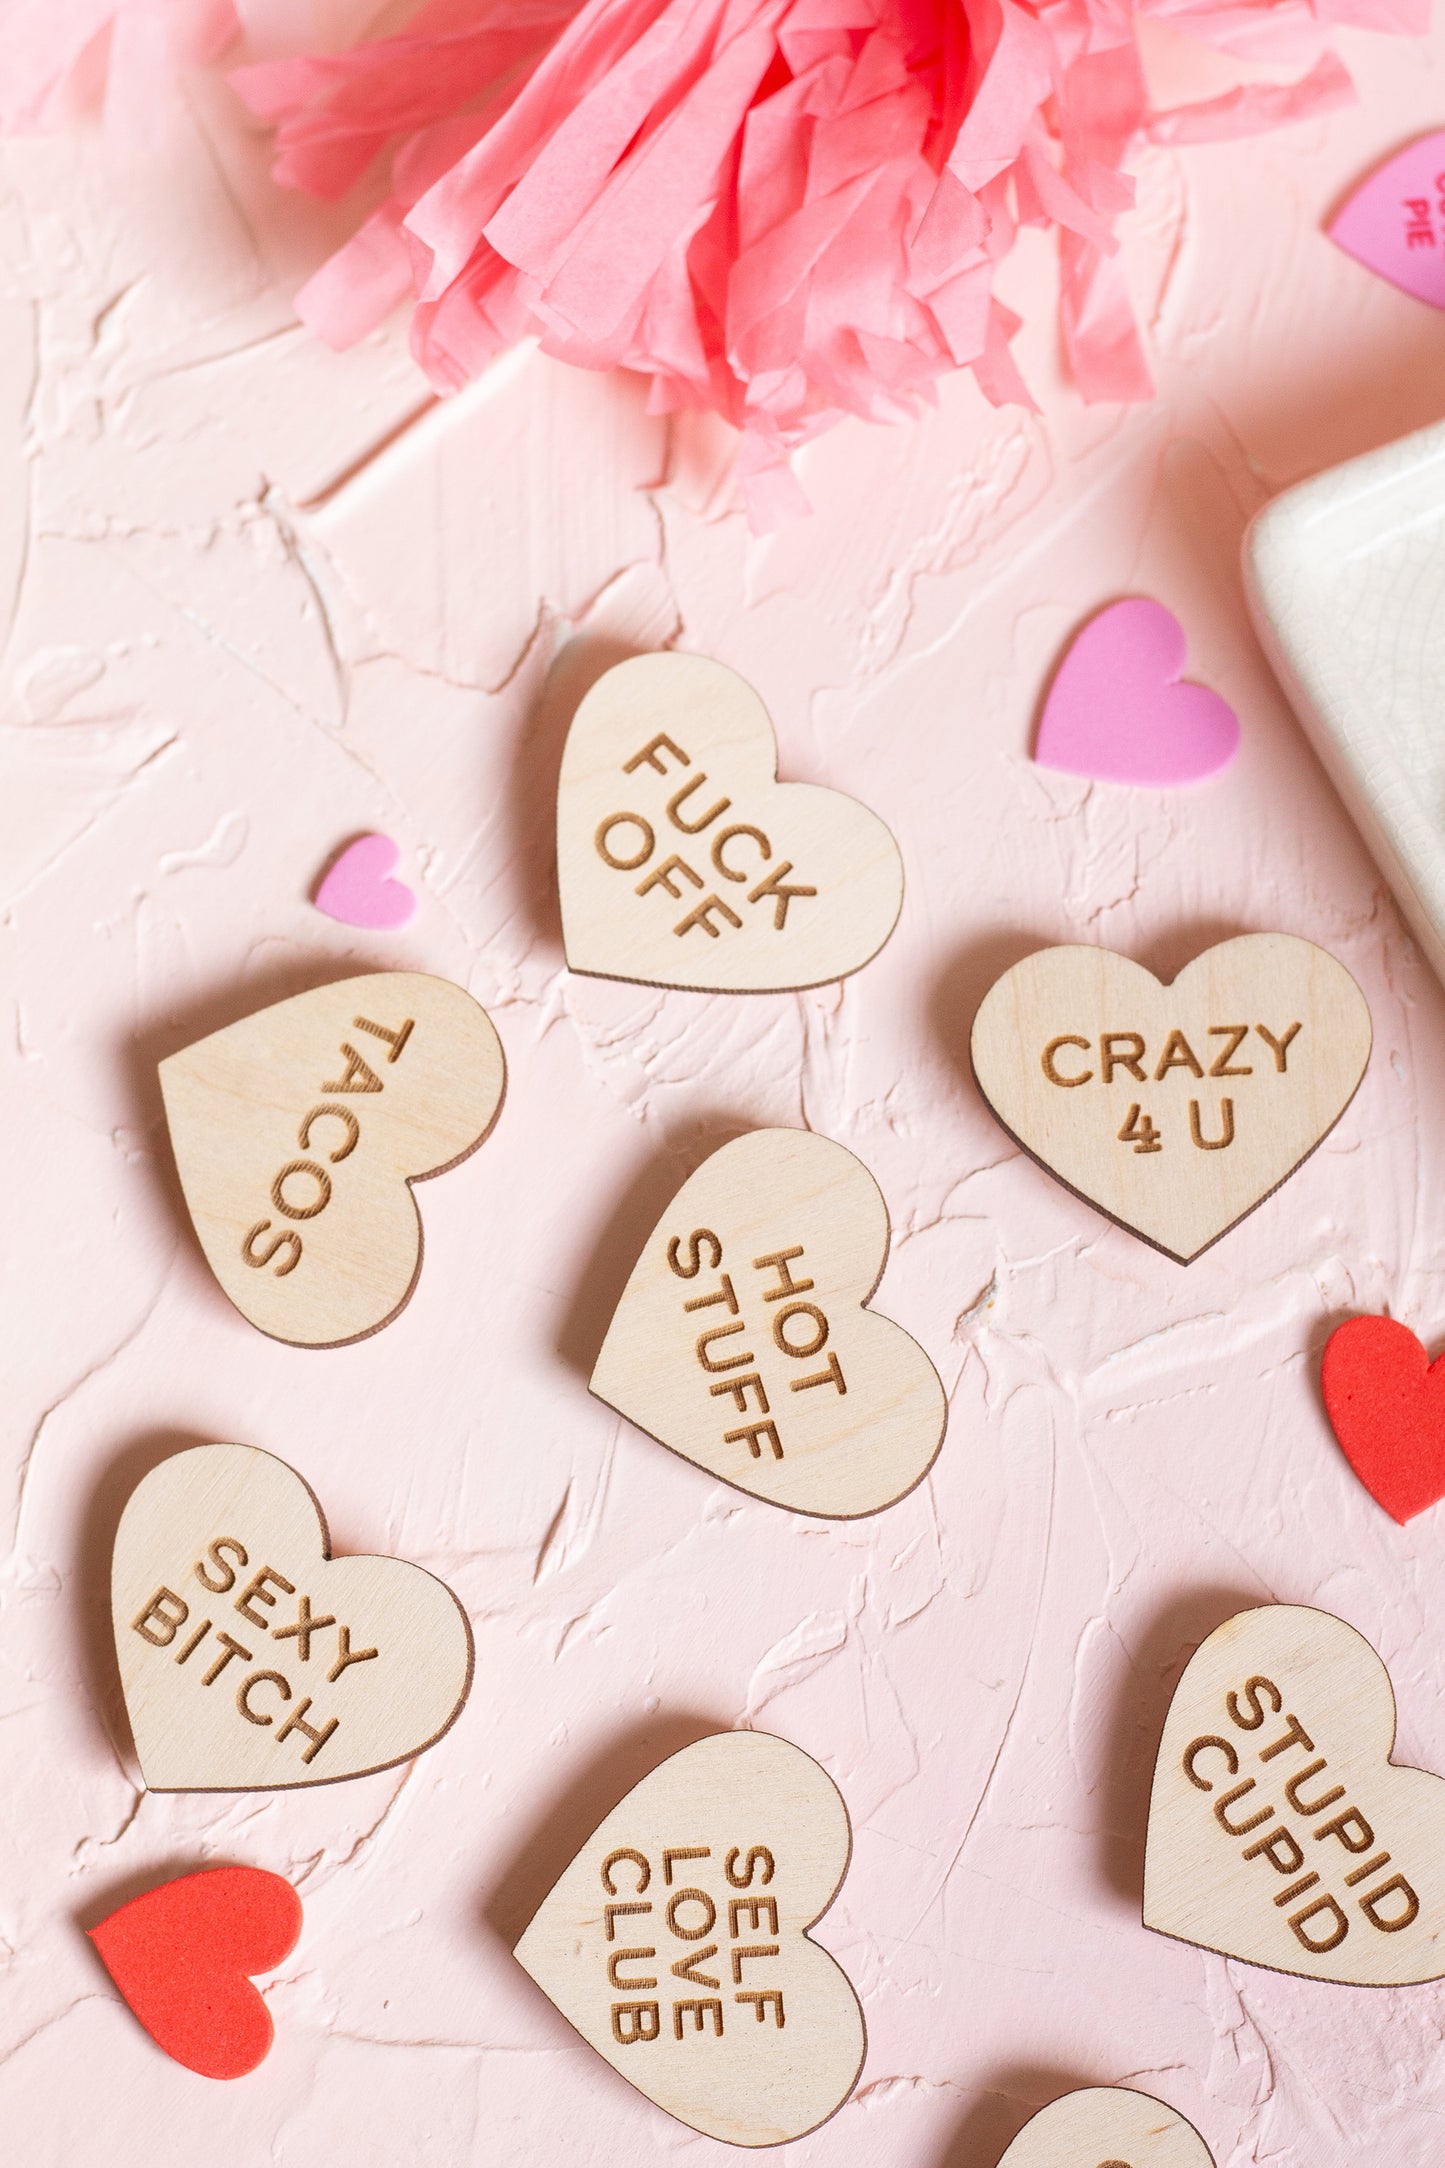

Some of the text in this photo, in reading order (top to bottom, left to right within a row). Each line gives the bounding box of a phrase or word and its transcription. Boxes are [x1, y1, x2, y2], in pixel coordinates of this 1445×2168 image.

[1403, 198, 1436, 249] PIE
[594, 811, 743, 938] OFF
[622, 732, 817, 930] FUCK
[240, 1015, 415, 1277] TACOS
[1041, 1022, 1302, 1087] CRAZY
[1117, 1097, 1234, 1153] 4 U
[667, 1228, 784, 1460] STUFF
[752, 1245, 847, 1395] HOT
[130, 1584, 339, 1764] BITCH
[193, 1536, 379, 1682] SEXY
[1182, 1735, 1349, 1954] CUPID
[1226, 1675, 1420, 1932] STUPID
[600, 1847, 660, 2045] CLUB
[662, 1846, 724, 2040] LOVE
[724, 1845, 785, 2029] SELF
